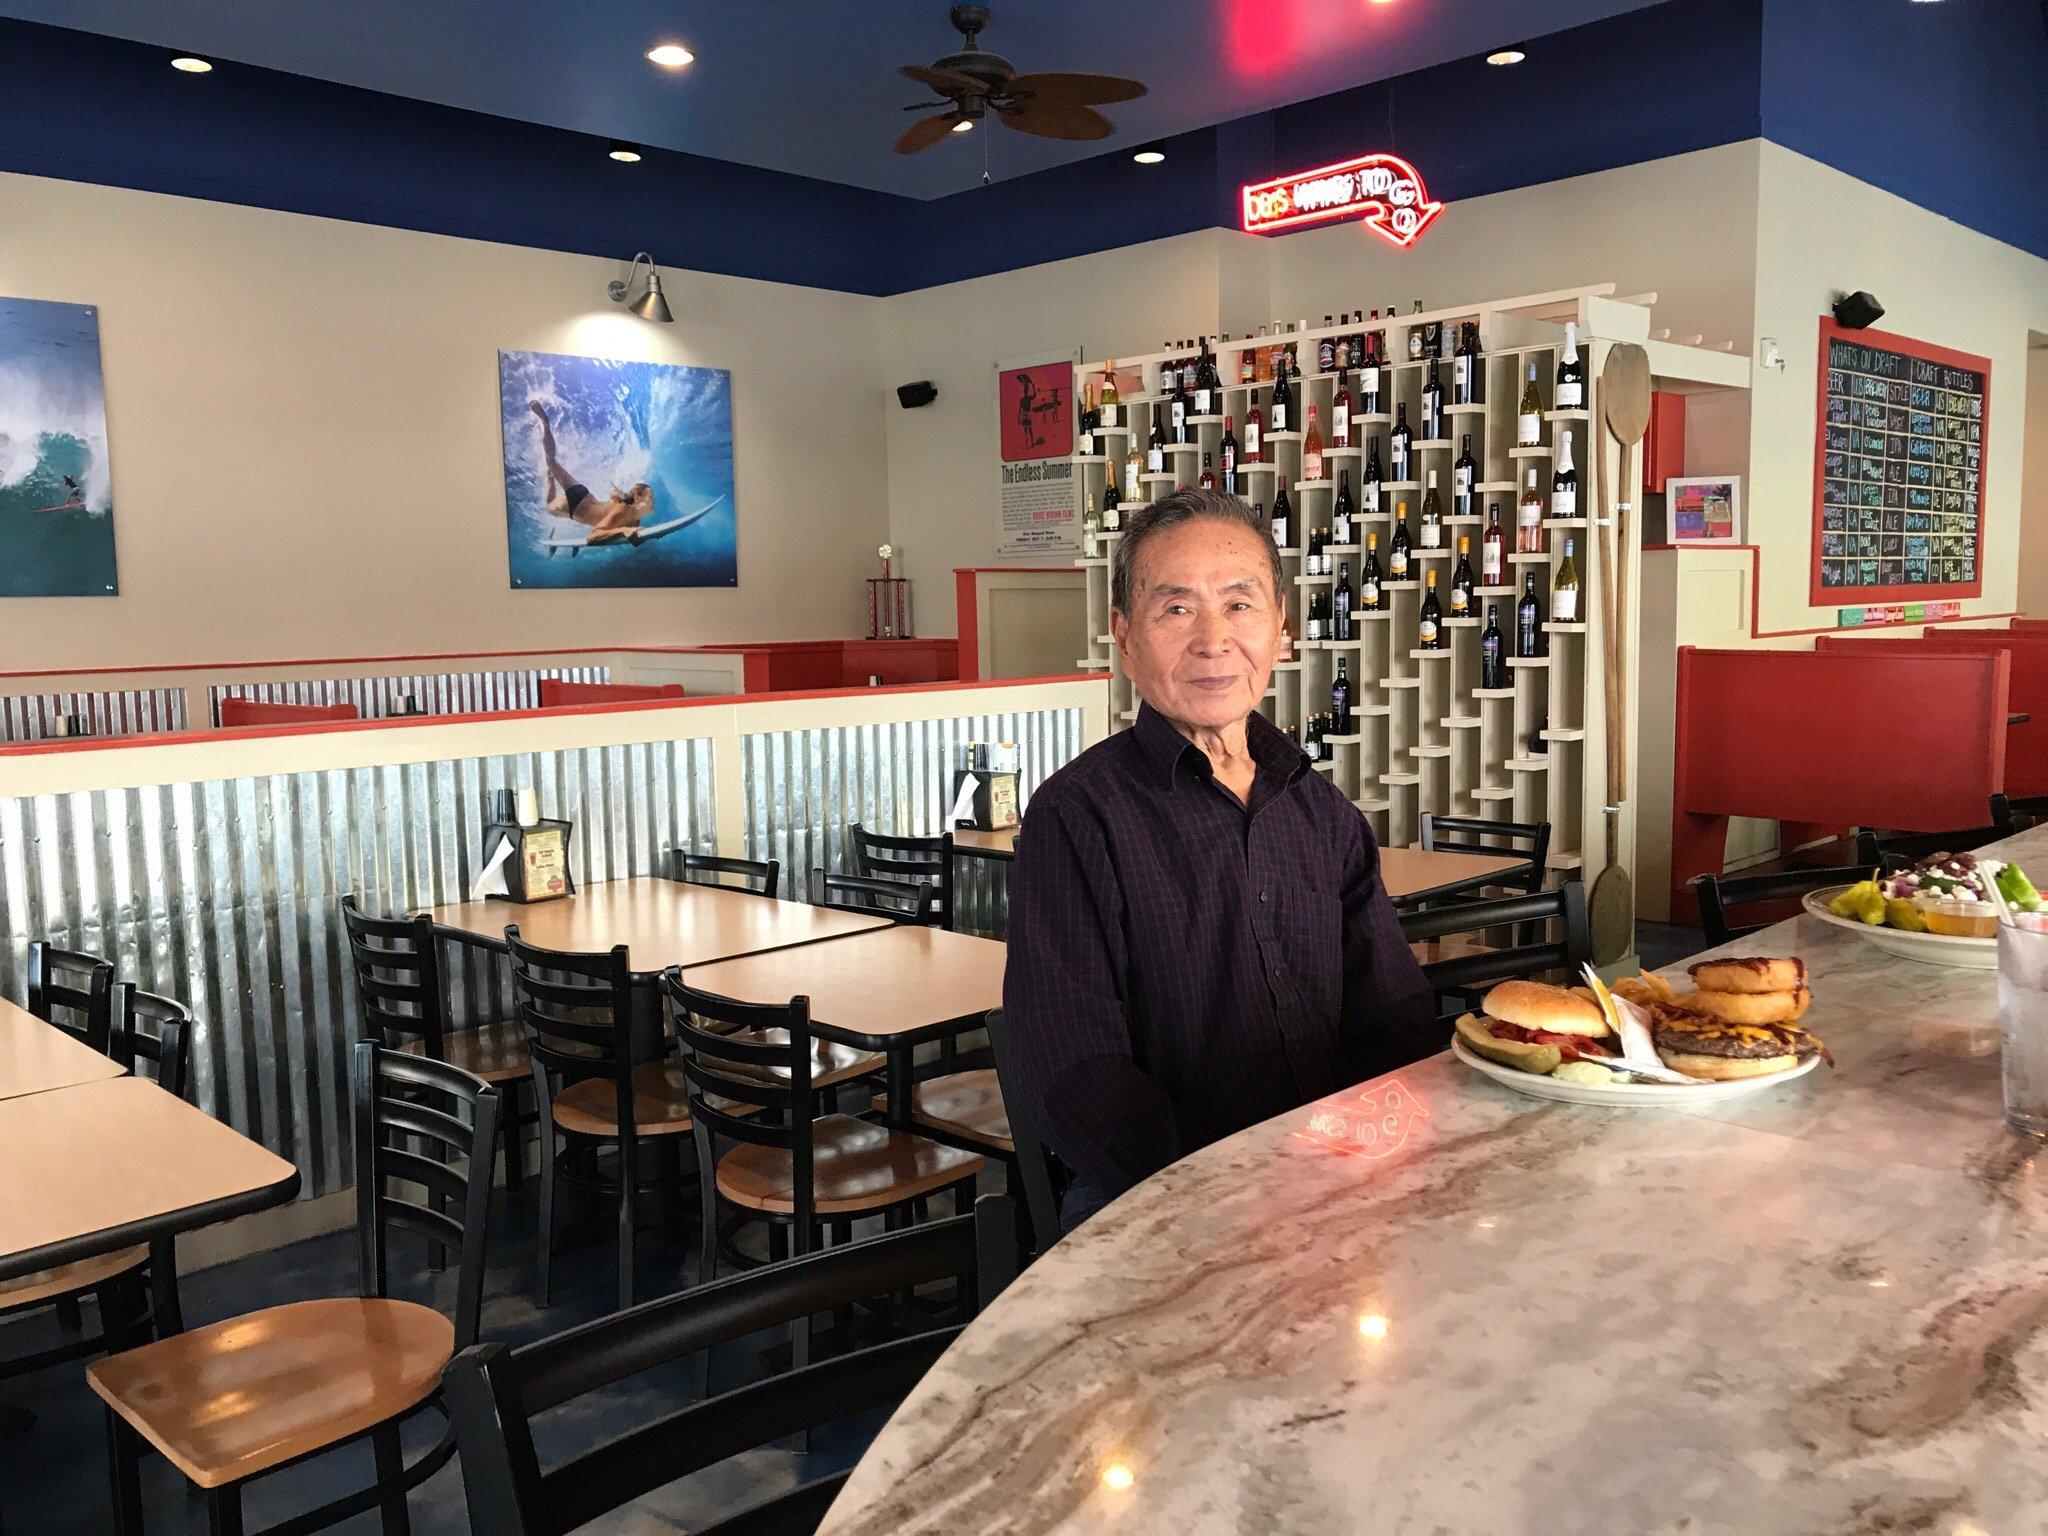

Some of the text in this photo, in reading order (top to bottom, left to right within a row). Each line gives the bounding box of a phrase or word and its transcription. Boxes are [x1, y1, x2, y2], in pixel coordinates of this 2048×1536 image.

[1874, 351, 1901, 378] DRAFT
[1917, 360, 1939, 383] CRAFT
[1889, 383, 1909, 401] STYLE
[1002, 461, 1073, 484] The Endless Summer
